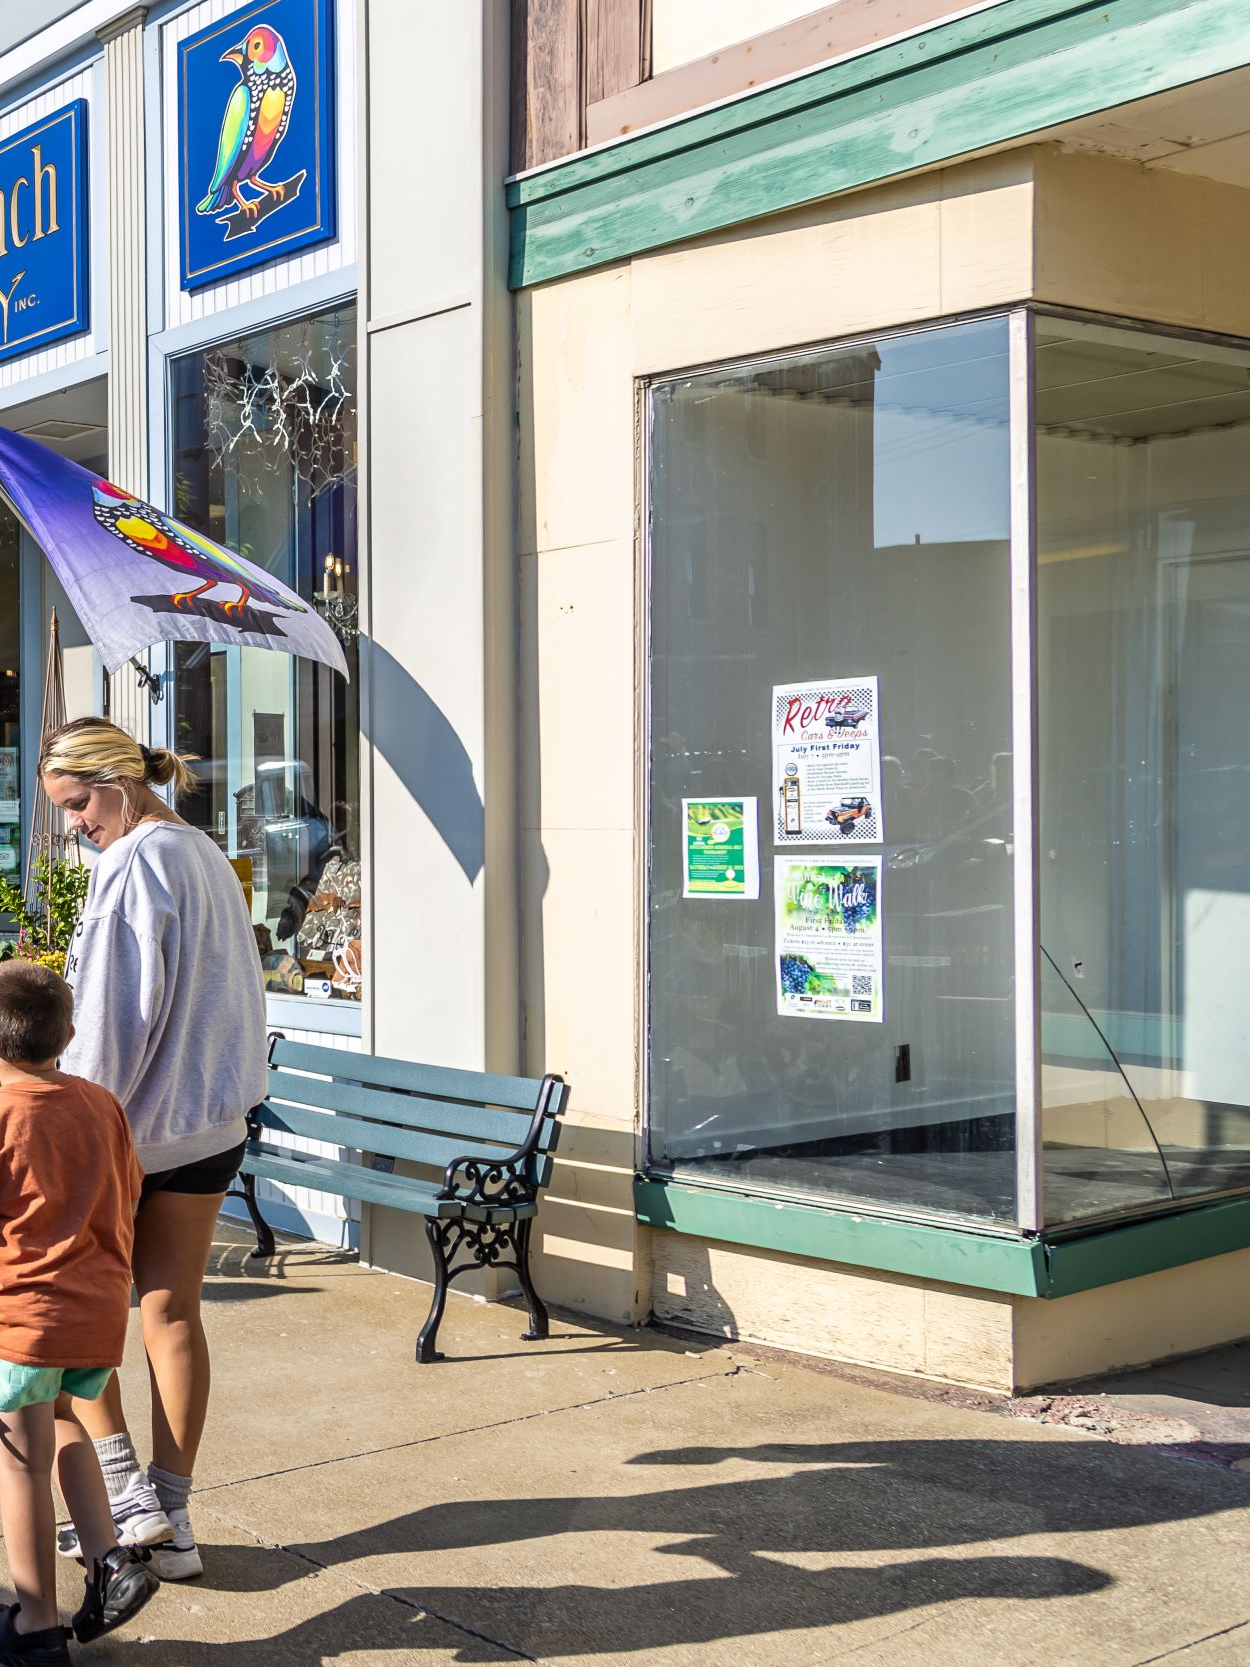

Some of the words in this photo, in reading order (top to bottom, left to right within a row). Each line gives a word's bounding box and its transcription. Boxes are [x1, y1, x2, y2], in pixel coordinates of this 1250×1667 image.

[14, 293, 41, 314] INC.
[783, 694, 854, 736] Retro
[801, 730, 824, 741] Cars
[827, 728, 835, 739] &
[837, 728, 869, 740] Jeeps
[790, 746, 808, 754] July
[810, 744, 830, 752] First
[832, 742, 860, 750] Friday
[828, 882, 868, 912] Walk
[805, 916, 822, 924] First
[824, 917, 844, 925] Frida
[790, 924, 813, 933] August
